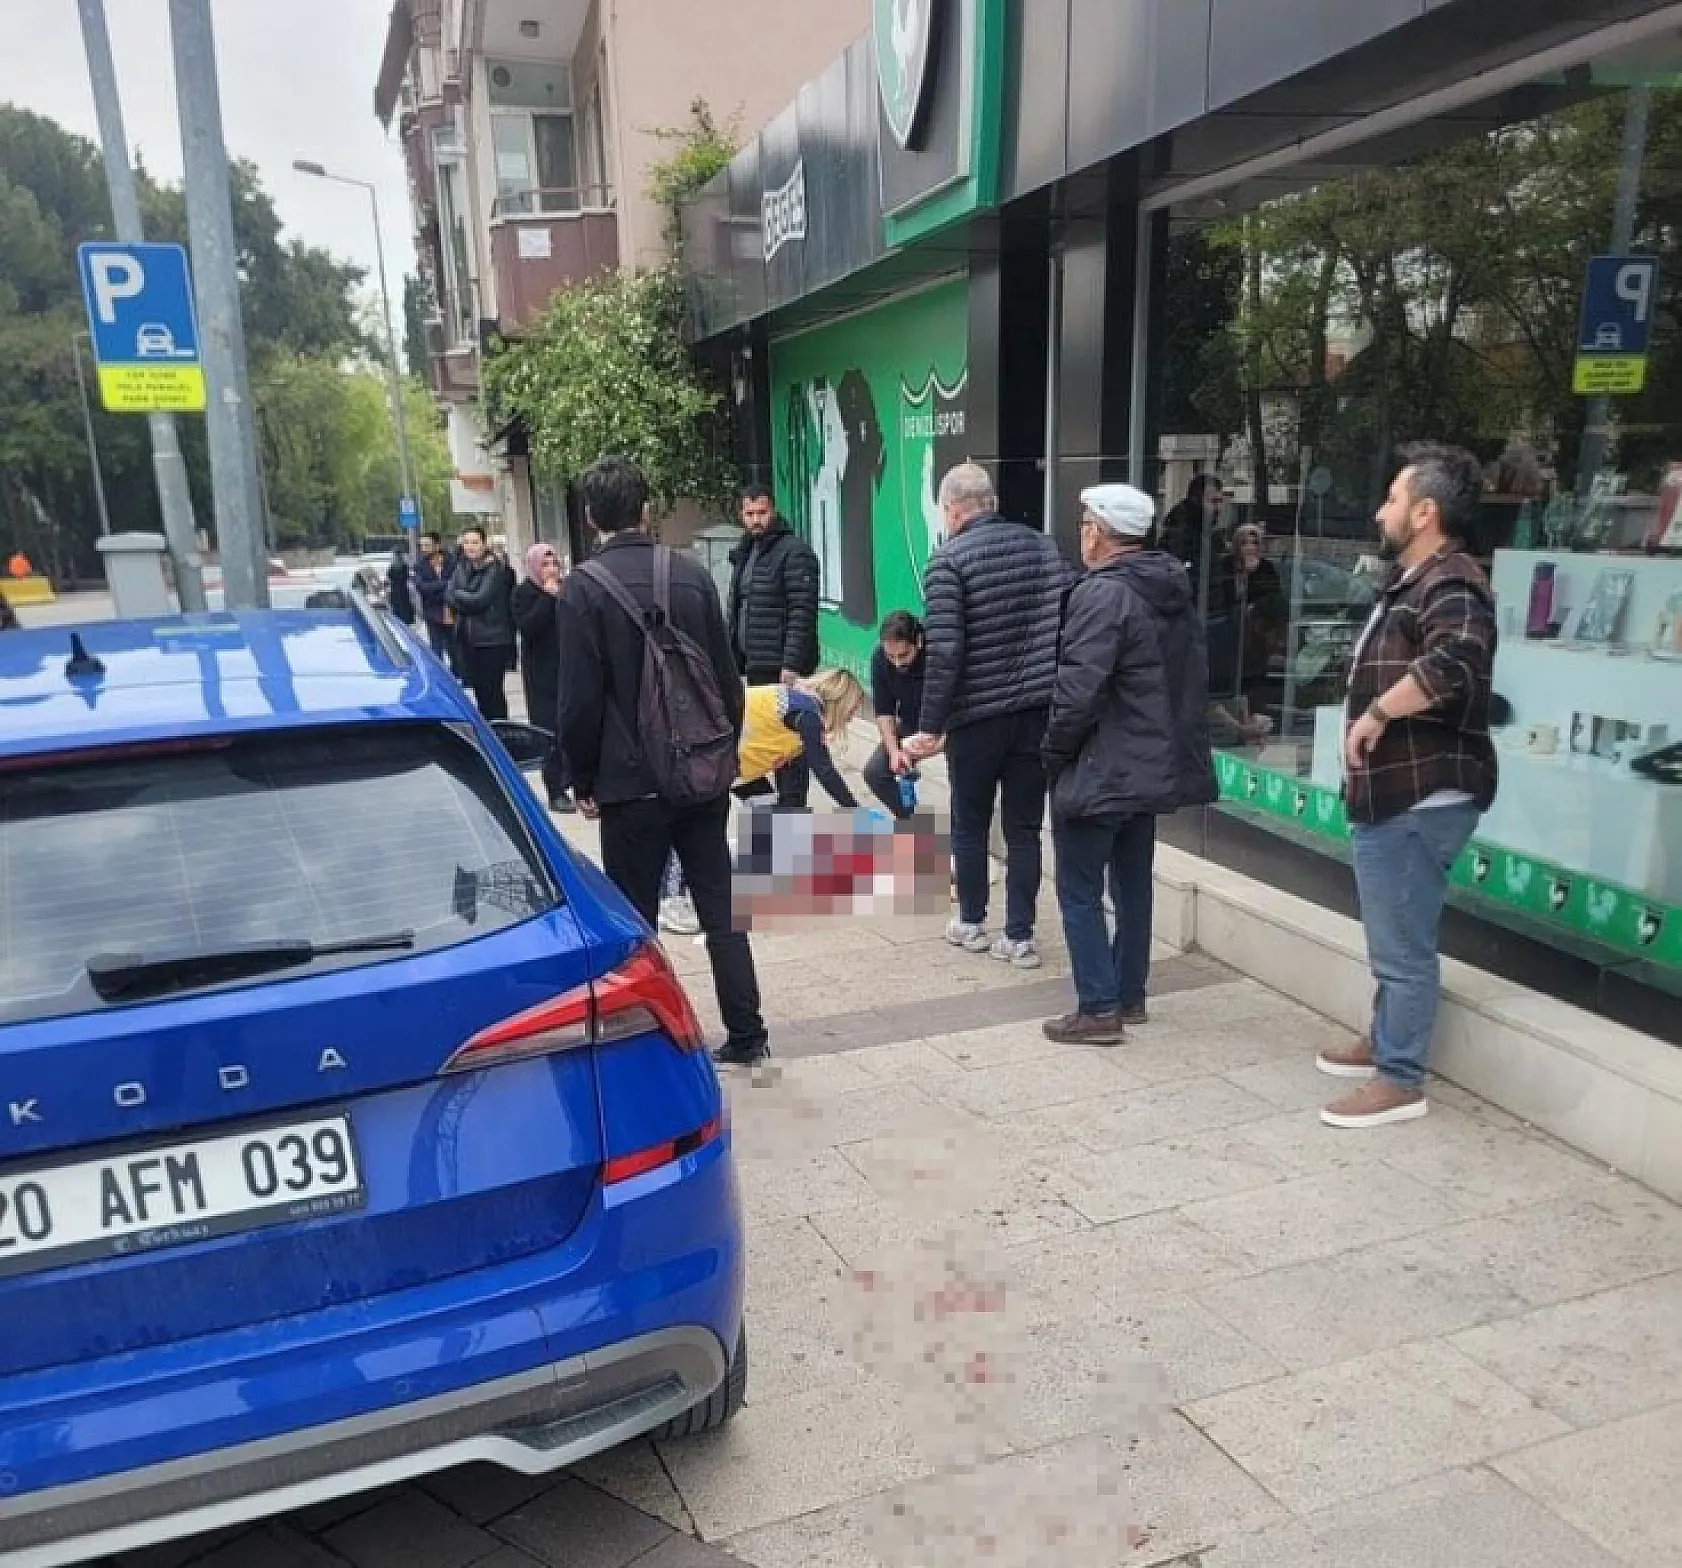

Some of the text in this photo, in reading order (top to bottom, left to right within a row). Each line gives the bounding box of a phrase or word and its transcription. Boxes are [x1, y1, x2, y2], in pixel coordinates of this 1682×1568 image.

[90, 253, 144, 323] P
[101, 1152, 207, 1228] AFM
[241, 1128, 349, 1198] 039
